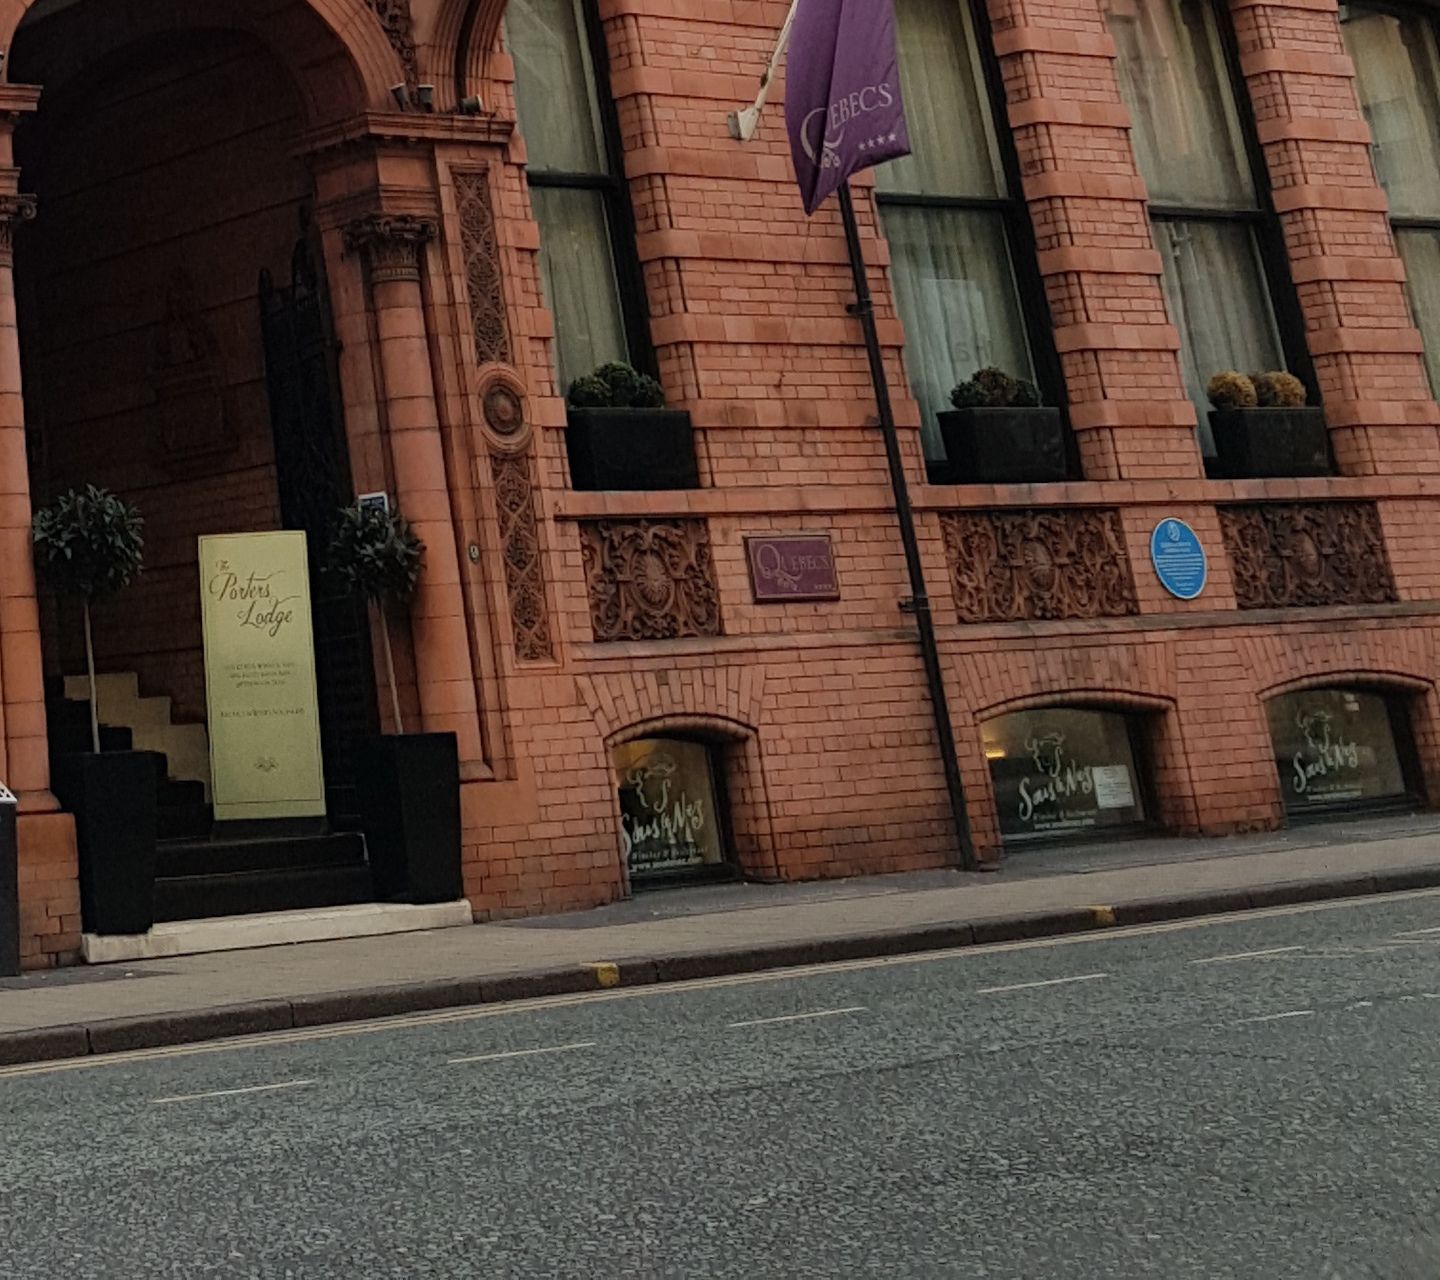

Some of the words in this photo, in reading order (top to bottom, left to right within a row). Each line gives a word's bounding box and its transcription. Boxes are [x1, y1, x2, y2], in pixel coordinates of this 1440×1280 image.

[800, 83, 893, 166] QEBECS
[209, 571, 280, 601] Porters
[237, 596, 297, 638] Lodge
